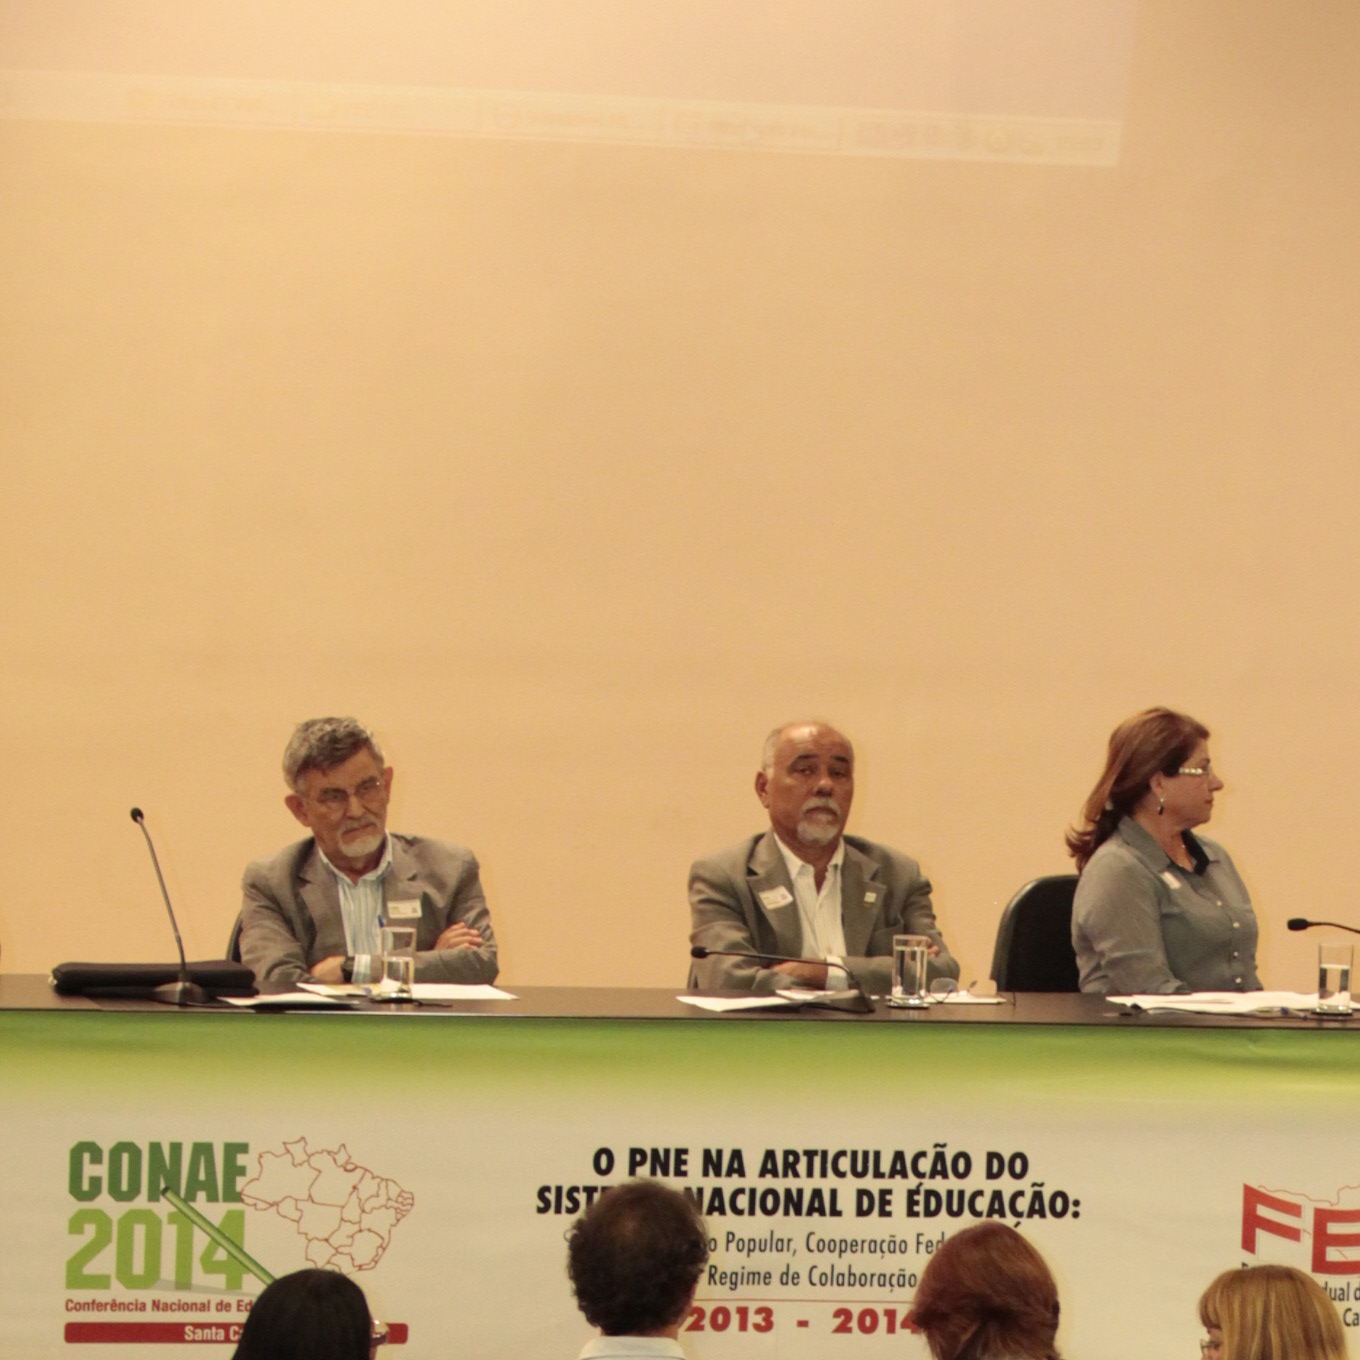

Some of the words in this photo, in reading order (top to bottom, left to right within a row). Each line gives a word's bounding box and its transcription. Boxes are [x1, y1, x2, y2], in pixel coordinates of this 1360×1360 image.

[68, 1141, 249, 1203] CONAE
[592, 1147, 615, 1177] O
[628, 1147, 689, 1178] PNE
[702, 1148, 746, 1179] NA
[758, 1143, 973, 1185] ARTICULAÇÃO
[985, 1151, 1029, 1181] DO
[536, 1185, 615, 1215] SIST
[855, 1188, 894, 1218] DE
[65, 1208, 251, 1291] 2014
[725, 1229, 797, 1259] Popular,
[806, 1231, 908, 1260] Cooperação
[707, 1264, 772, 1292] Regime
[779, 1263, 801, 1286] de
[65, 1298, 147, 1312] Conferência
[151, 1299, 211, 1313] Nacional
[215, 1299, 232, 1312] de
[684, 1306, 774, 1333] 2013
[184, 1325, 225, 1341] Santa
